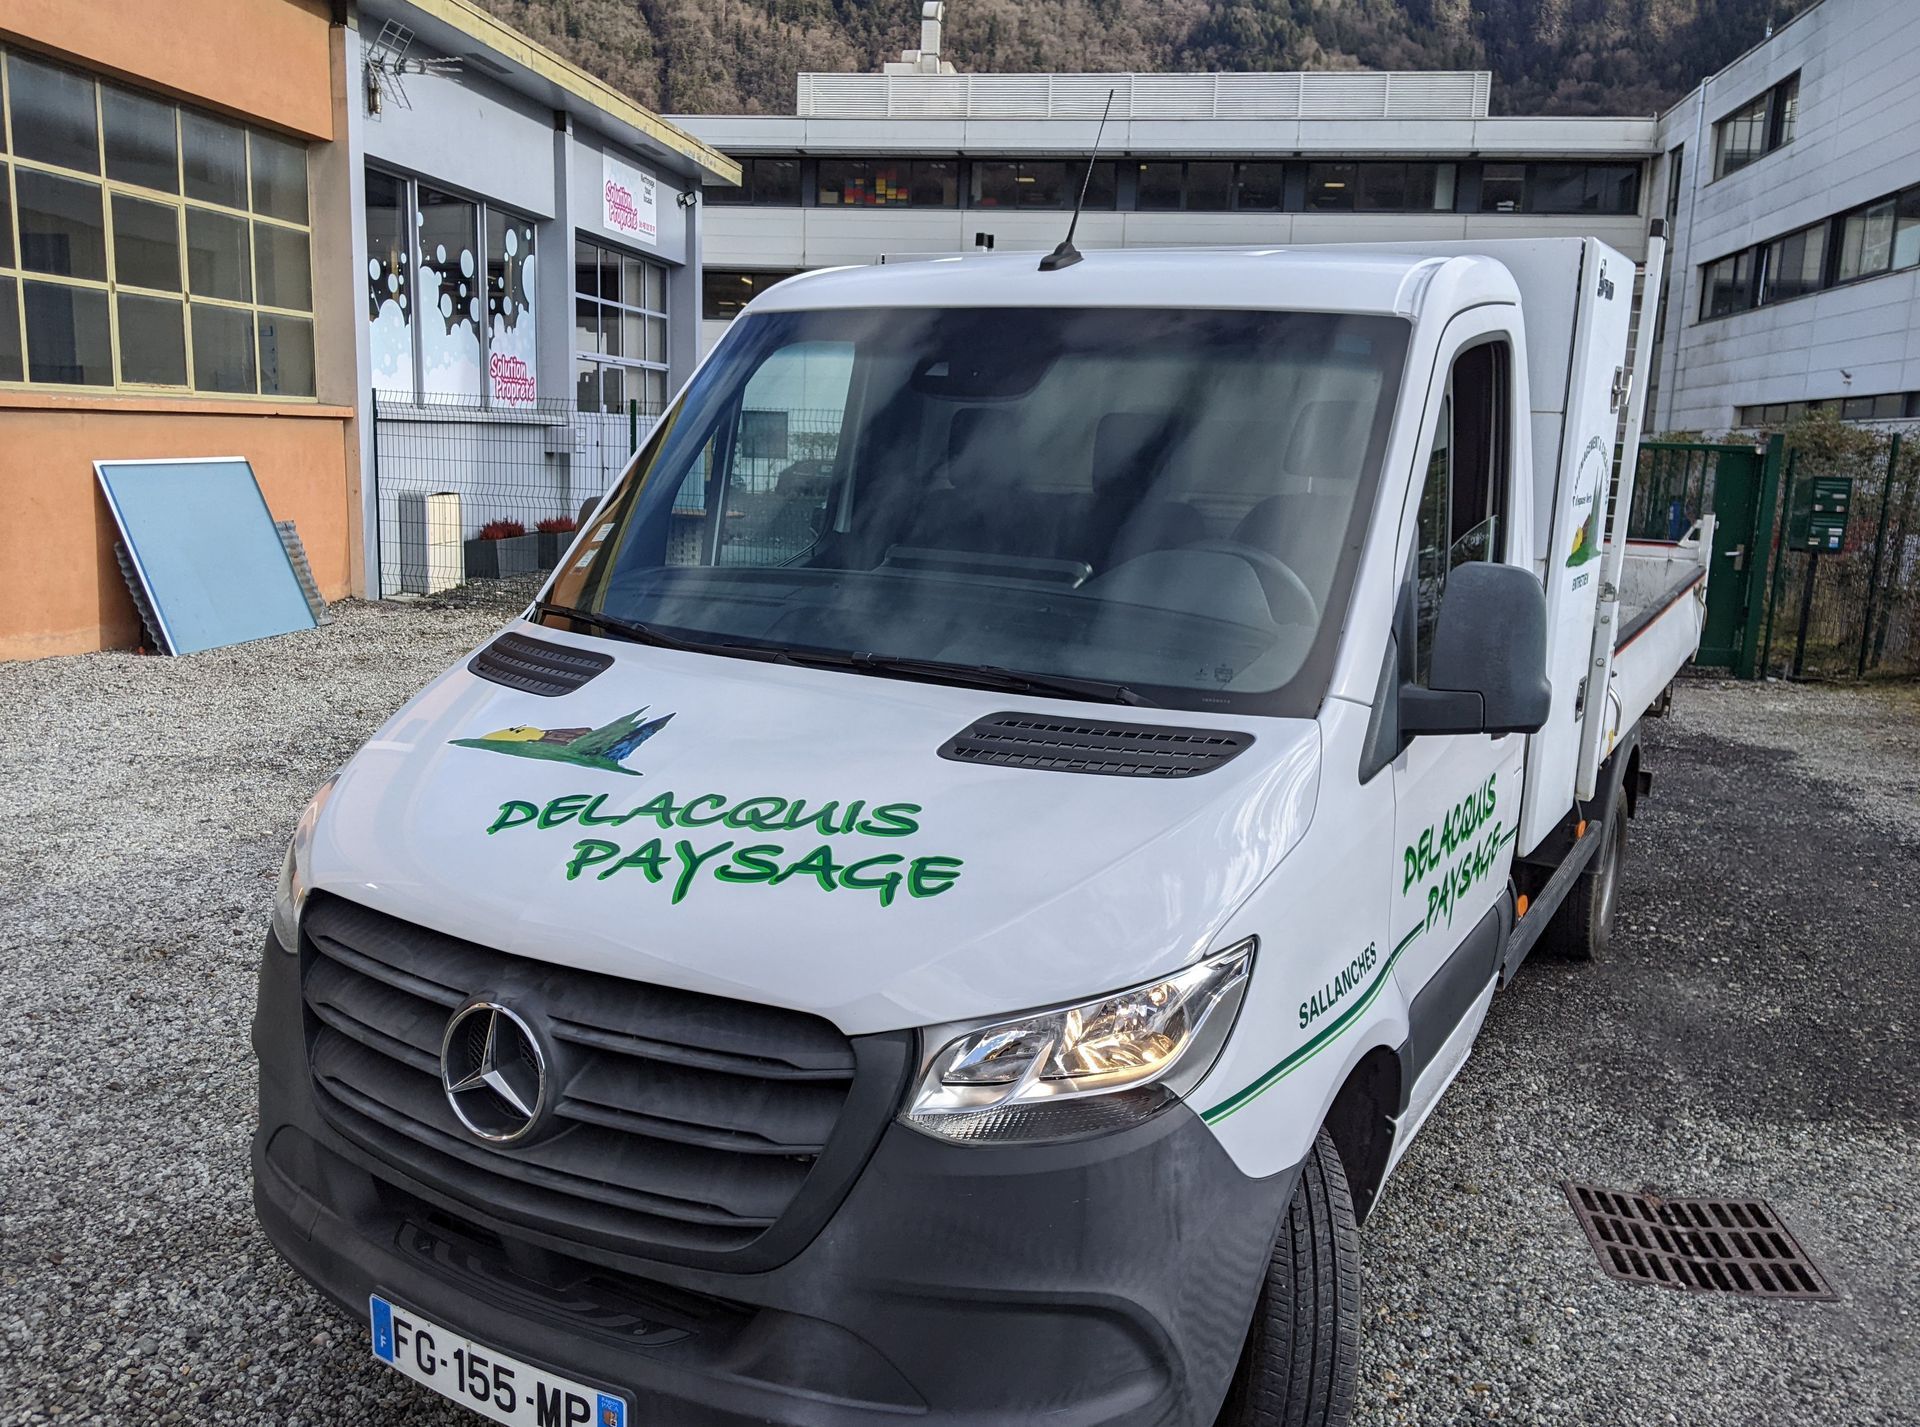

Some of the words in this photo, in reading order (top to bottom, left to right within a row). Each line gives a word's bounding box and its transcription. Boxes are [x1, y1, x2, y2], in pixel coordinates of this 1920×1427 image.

[606, 180, 633, 211] Solution
[609, 202, 638, 231] Propreté
[490, 352, 528, 380] Solution
[495, 377, 535, 406] Propreté
[486, 791, 923, 837] DELACQUIS
[1403, 772, 1497, 897] DELACQUIS
[566, 838, 964, 907] PAYSAGE
[1426, 820, 1502, 934] PAYSAGE
[1299, 941, 1377, 1029] SALLANCHES
[380, 1334, 388, 1348] F
[393, 1315, 591, 1427] FG-155-MP
